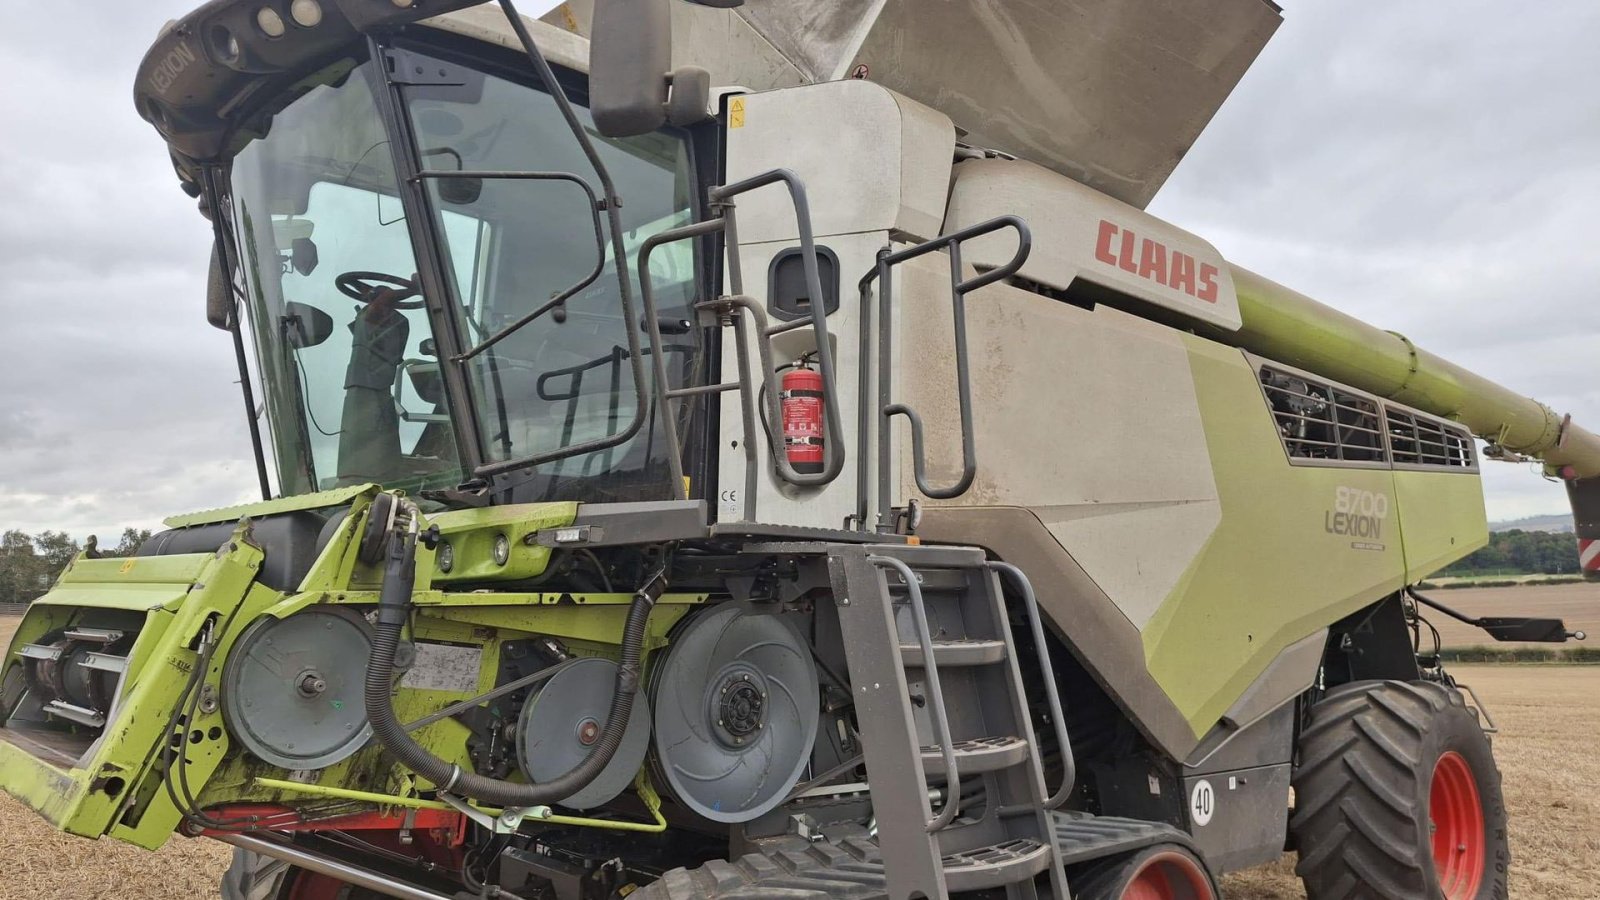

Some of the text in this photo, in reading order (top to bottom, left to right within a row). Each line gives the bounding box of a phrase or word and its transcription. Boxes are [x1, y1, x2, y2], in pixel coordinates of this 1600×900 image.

[149, 41, 196, 95] LEXION
[1095, 219, 1218, 304] CLAAS
[721, 490, 736, 502] CE
[1335, 485, 1388, 520] 8700
[1324, 509, 1381, 540] LEXION
[1195, 787, 1210, 816] 40
